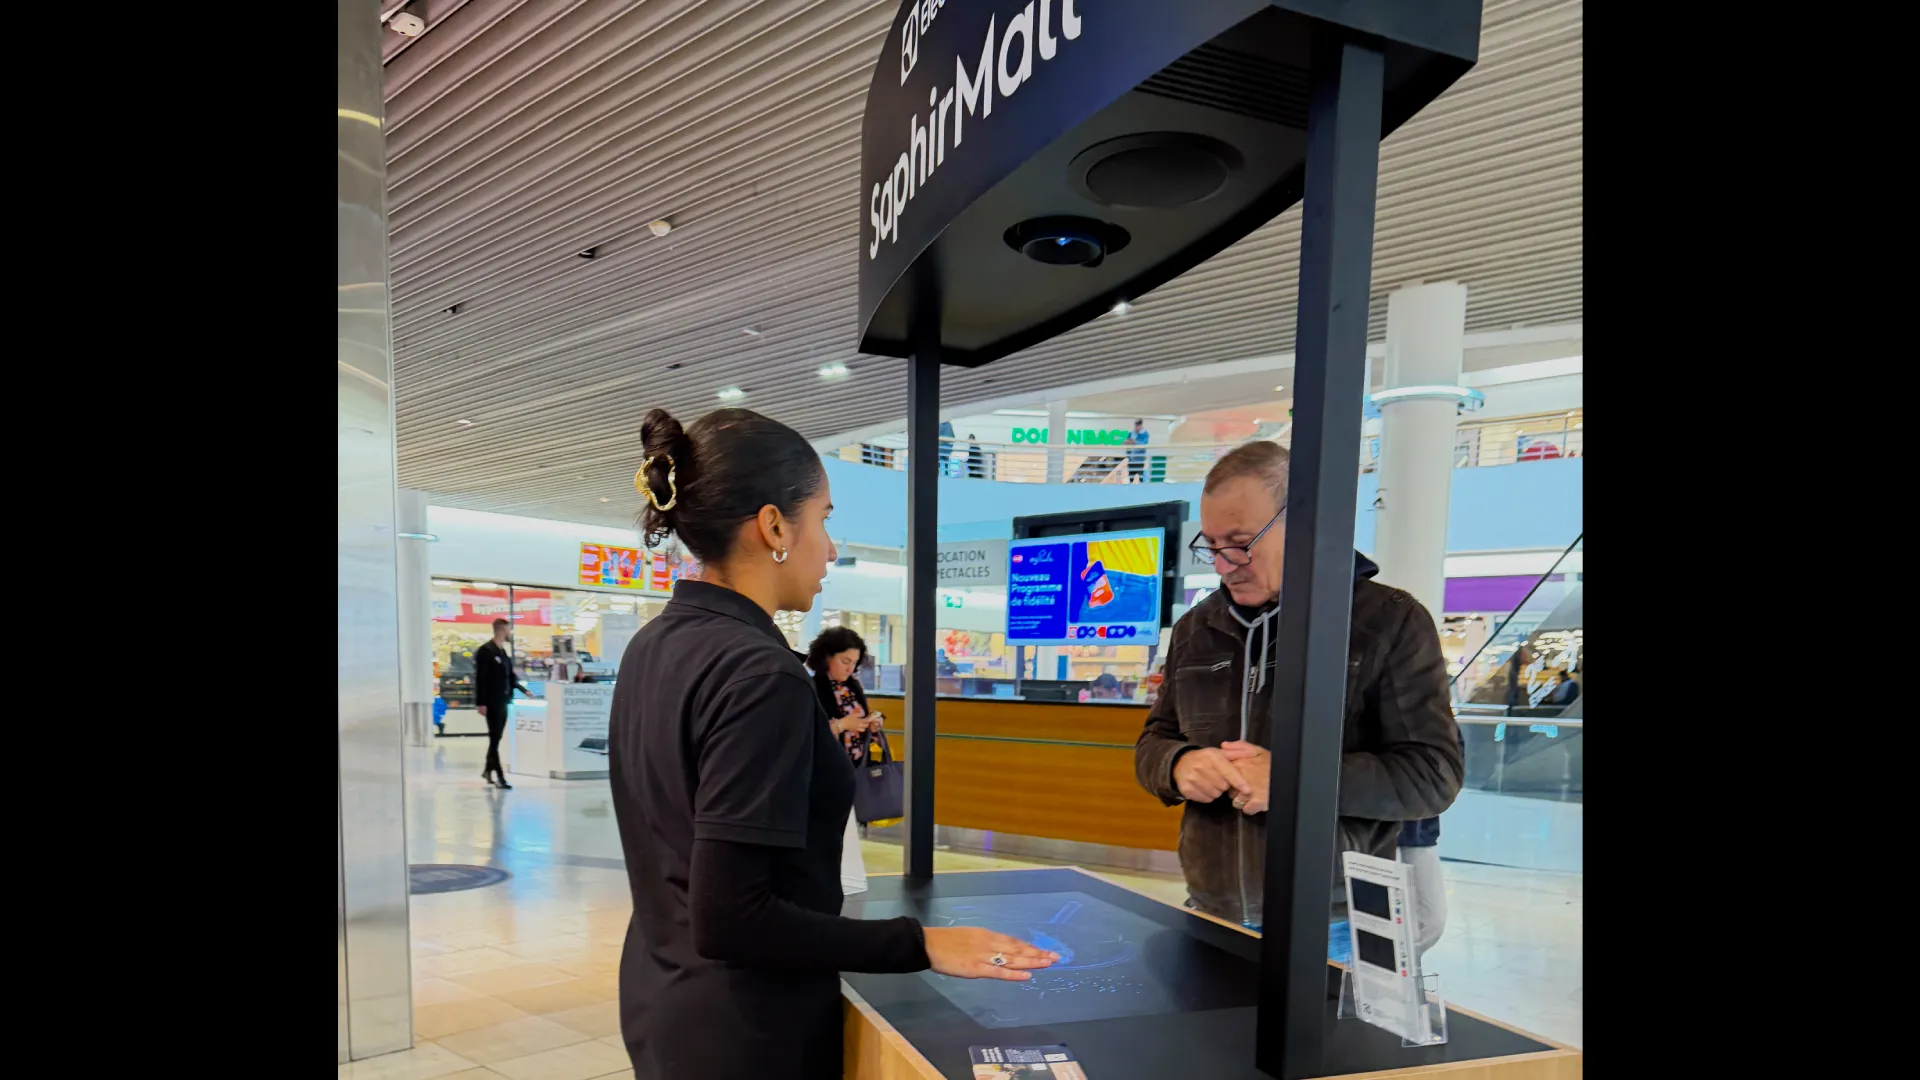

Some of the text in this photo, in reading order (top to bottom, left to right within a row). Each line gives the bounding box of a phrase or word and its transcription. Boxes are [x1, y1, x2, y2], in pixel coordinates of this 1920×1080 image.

[937, 550, 985, 562] OCATION
[937, 566, 990, 579] ECTACLES
[1012, 573, 1050, 582] Nouveau
[1012, 584, 1062, 595] Programme
